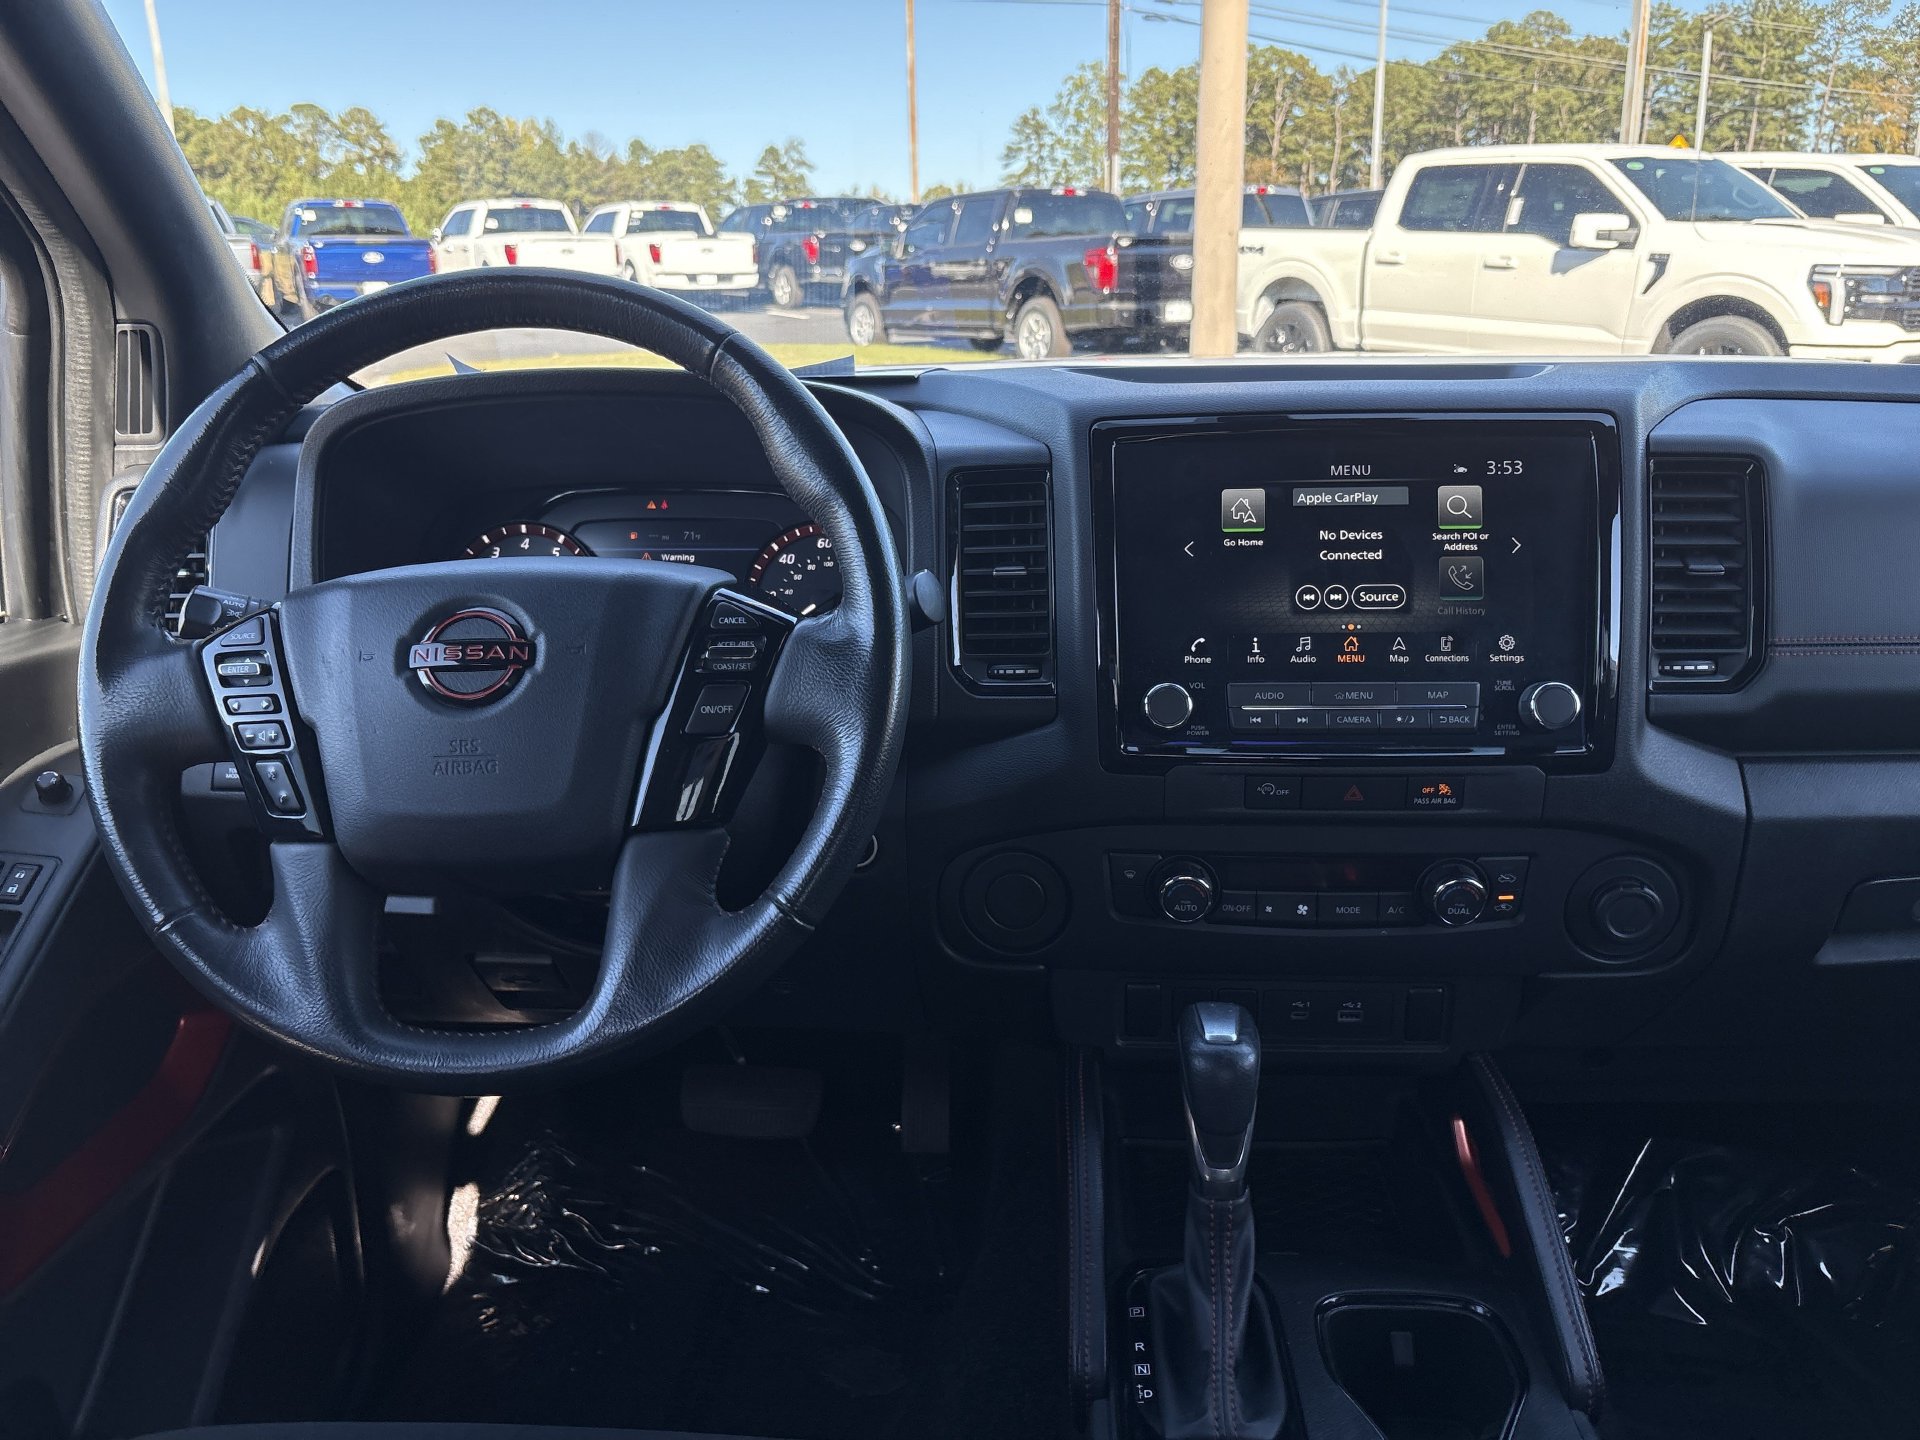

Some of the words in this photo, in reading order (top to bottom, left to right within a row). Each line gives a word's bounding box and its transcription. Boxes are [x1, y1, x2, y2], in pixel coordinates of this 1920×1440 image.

[1330, 465, 1371, 476] MENU
[1486, 460, 1523, 474] 3:53
[1297, 493, 1332, 505] Apple
[1334, 492, 1379, 504] CarPlay
[1320, 531, 1336, 540] No
[1340, 530, 1383, 540] Devices
[1432, 533, 1460, 541] Search
[1463, 532, 1477, 540] POI
[520, 537, 530, 550] 4
[1223, 538, 1237, 547] Go
[1239, 538, 1264, 547] Home
[1443, 542, 1478, 551] Address
[491, 546, 501, 558] 3
[1320, 550, 1383, 560] Connected
[661, 553, 695, 563] Warning
[779, 553, 796, 565] 40
[1359, 591, 1399, 602] Source
[223, 599, 246, 609] AUTO
[1437, 606, 1454, 616] Call
[1456, 606, 1486, 617] History
[718, 616, 747, 624] CANCEL
[230, 632, 256, 640] SOURCE
[413, 644, 530, 664] NISSAN
[1184, 654, 1212, 664] Phone
[1247, 654, 1265, 664] Info
[1290, 654, 1317, 664] Audio
[1337, 654, 1366, 663] MENU
[1425, 653, 1469, 663] Connections
[1489, 653, 1525, 664] Settings
[1389, 654, 1410, 665] Map
[227, 664, 250, 673] ENTER
[713, 662, 752, 670] COAST/SET
[1188, 682, 1206, 690] VOL
[1254, 692, 1285, 700] AUDIO
[1345, 691, 1373, 700] MENU
[1427, 691, 1449, 700] MAP
[700, 705, 734, 714] ON/OFF
[1336, 716, 1371, 724] CAMERA
[1448, 716, 1470, 724] BACK
[449, 740, 480, 753] SRS
[432, 760, 500, 777] AIRBAG
[1336, 906, 1361, 915] MODE
[1387, 905, 1405, 915] A/C
[1447, 907, 1471, 915] DUAL
[1134, 1342, 1145, 1352] R
[1143, 1389, 1153, 1398] D
